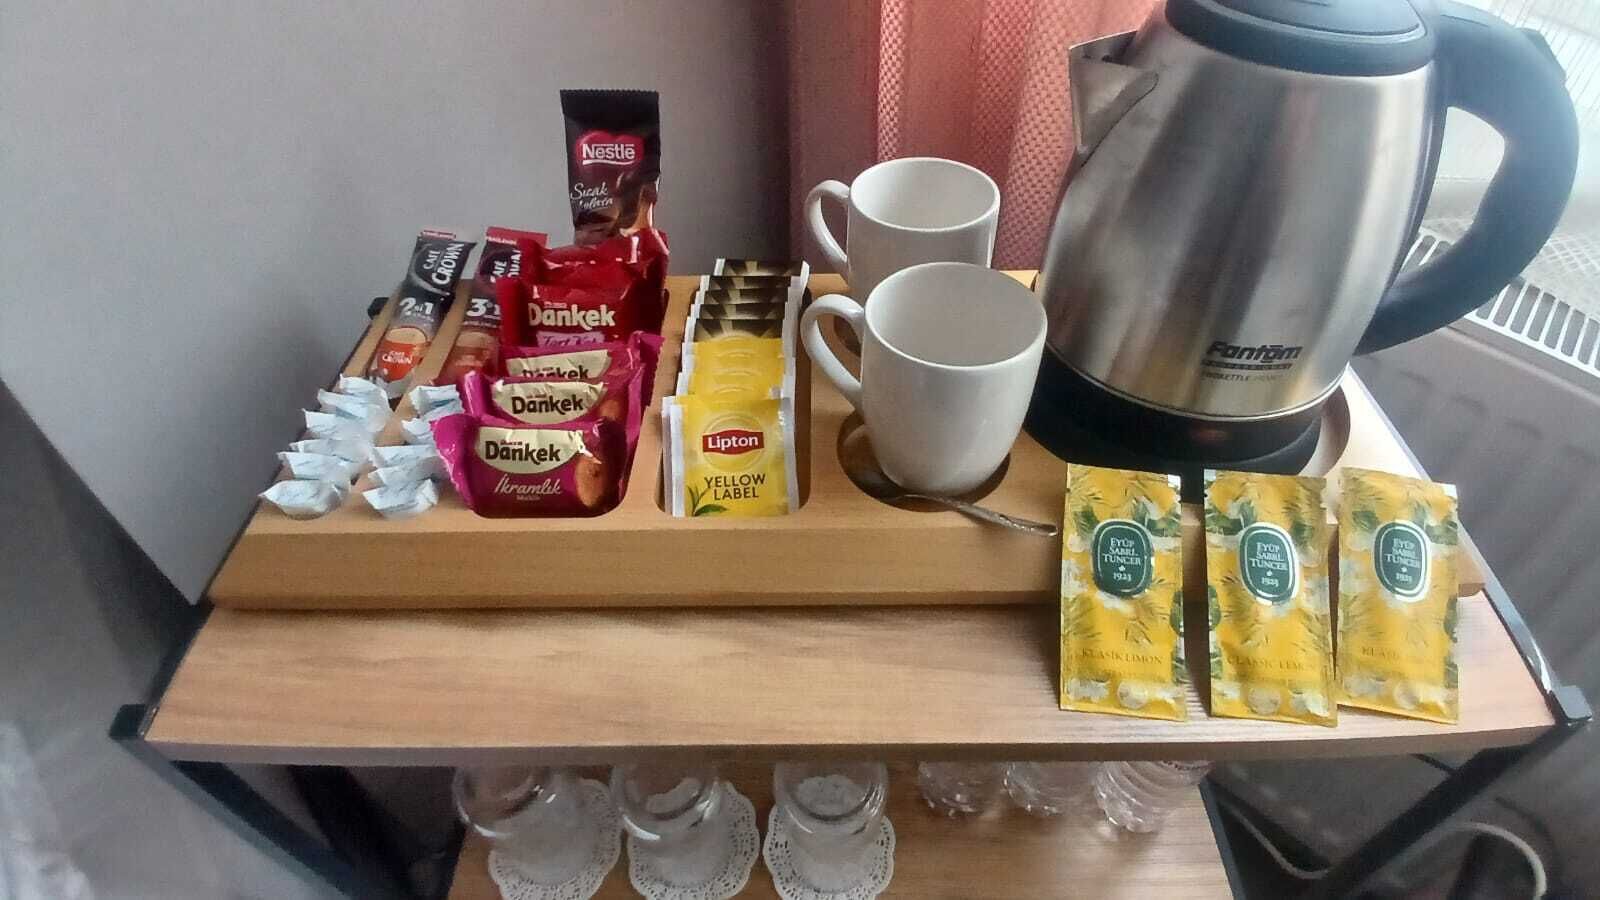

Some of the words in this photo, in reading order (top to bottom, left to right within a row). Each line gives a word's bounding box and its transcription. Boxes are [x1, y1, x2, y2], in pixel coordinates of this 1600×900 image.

[431, 243, 465, 285] CROWN
[528, 302, 616, 331] Dankek
[512, 395, 584, 416] Dankek
[708, 435, 759, 451] Lipton
[485, 440, 561, 465] Dankek
[704, 473, 766, 489] YELLOW
[713, 487, 760, 501] LABEL
[1102, 553, 1141, 566] TUNCER
[1249, 557, 1289, 571] TUNCER
